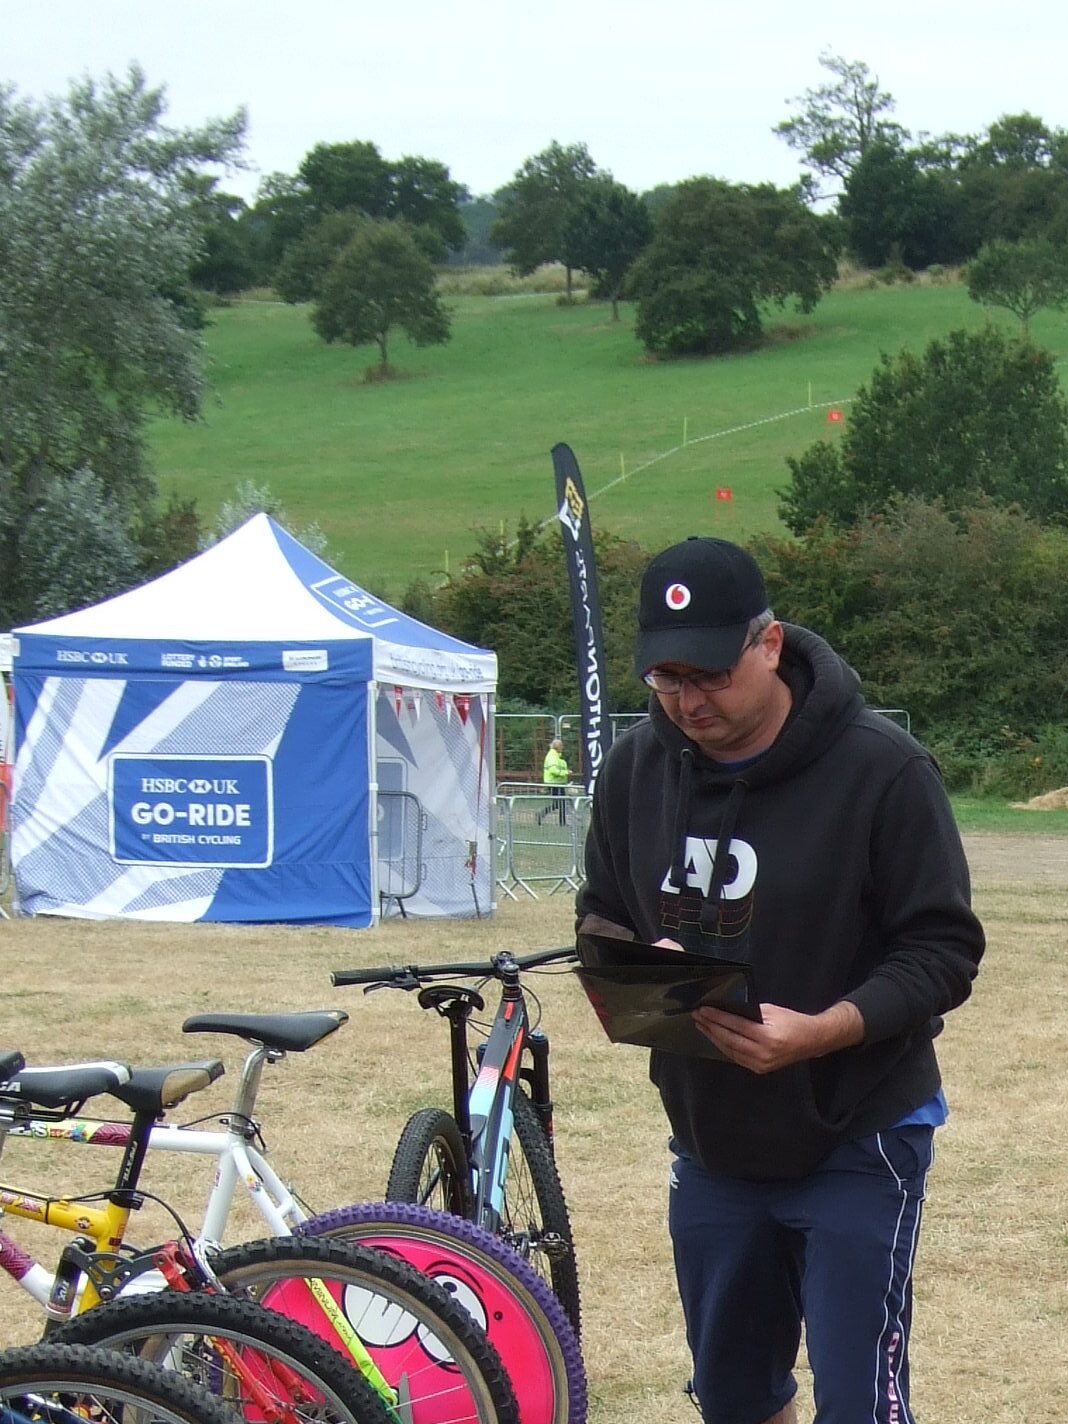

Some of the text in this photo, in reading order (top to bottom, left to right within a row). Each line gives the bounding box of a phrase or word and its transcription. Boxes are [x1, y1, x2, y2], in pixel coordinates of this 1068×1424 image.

[56, 649, 129, 665] HSBC UK
[141, 777, 241, 795] HSBC UK
[130, 801, 252, 827] GO-RIDE
[152, 833, 196, 845] BRITISH
[197, 835, 242, 846] CYCLING
